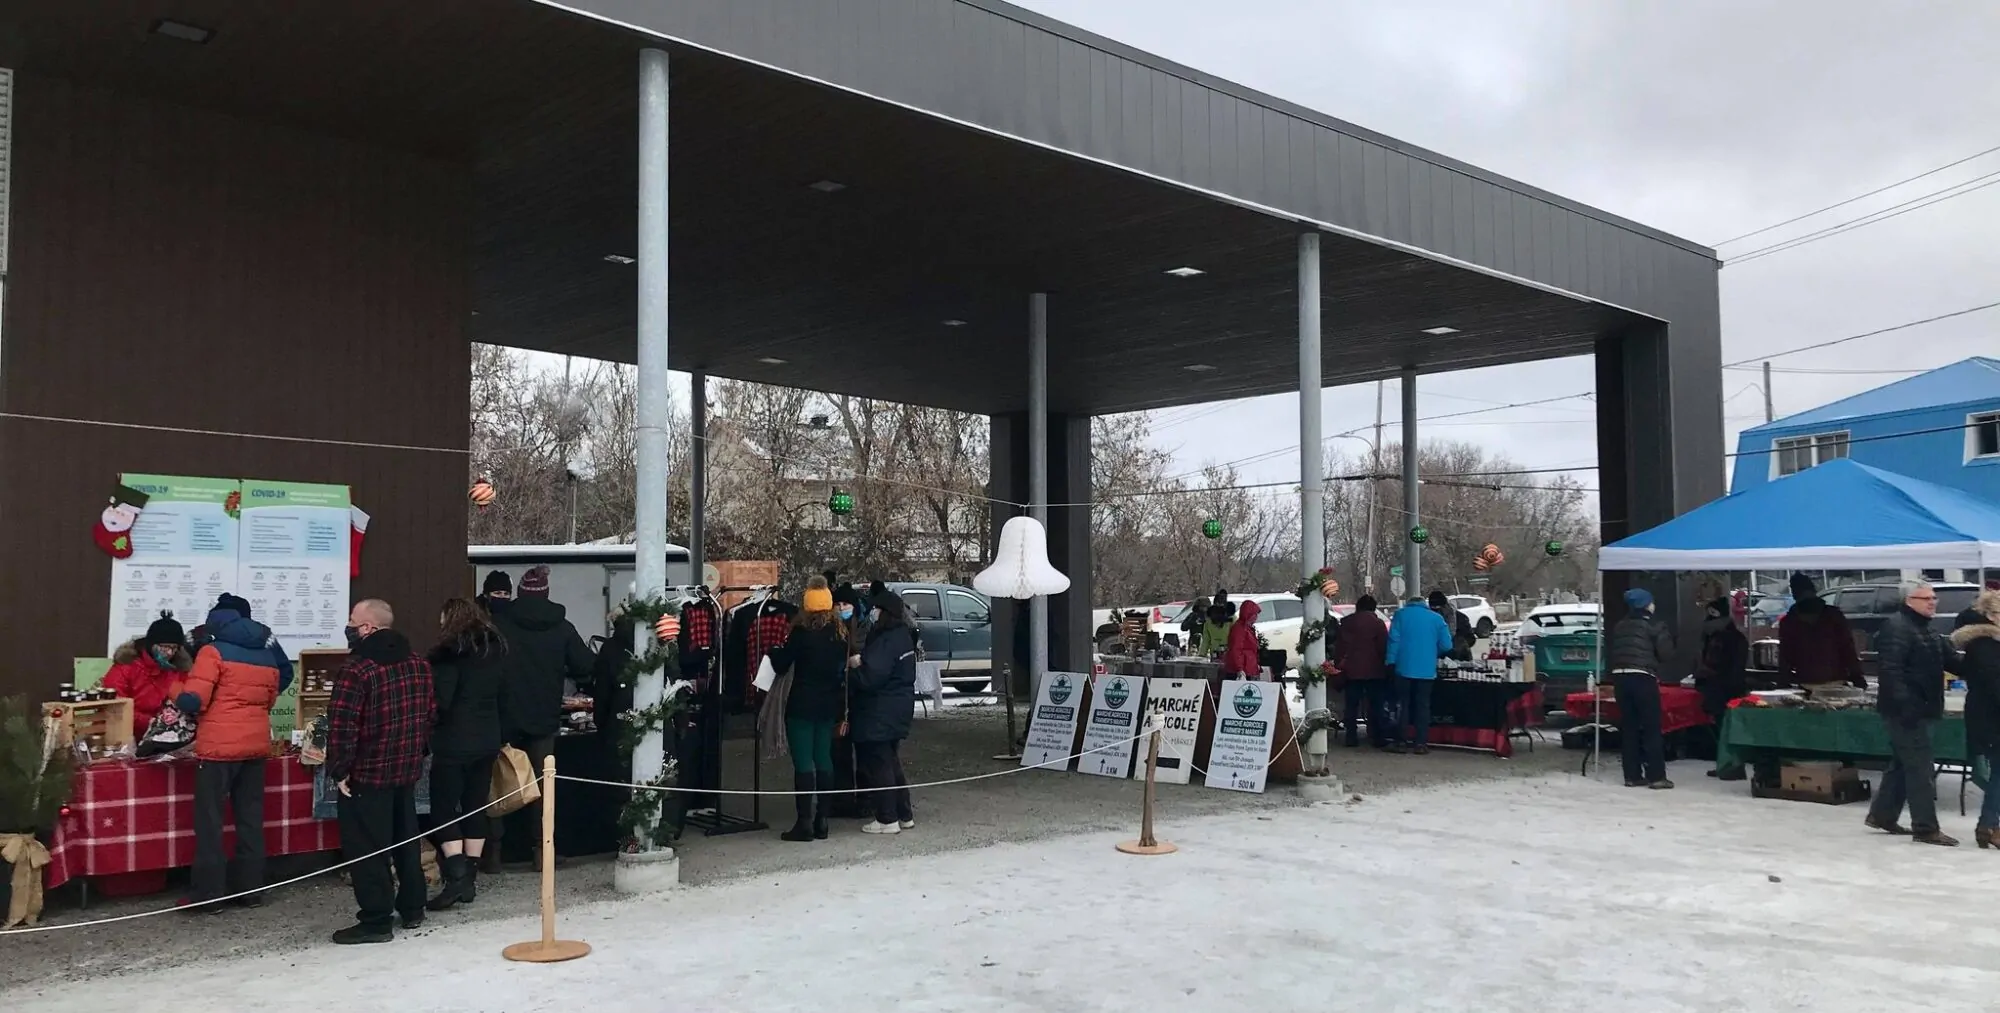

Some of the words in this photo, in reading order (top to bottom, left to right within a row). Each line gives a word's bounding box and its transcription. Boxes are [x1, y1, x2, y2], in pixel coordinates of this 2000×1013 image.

[251, 489, 286, 498] COVID-19
[1146, 694, 1200, 713] MARCHÉ
[1143, 715, 1196, 732] AICOLE
[1224, 719, 1243, 727] MARCHÉ
[1243, 721, 1265, 729] AGRICOLE
[1223, 727, 1244, 735] FARMER'S
[1110, 767, 1118, 775] KM
[1238, 779, 1249, 789] 500
[1249, 781, 1256, 789] M
